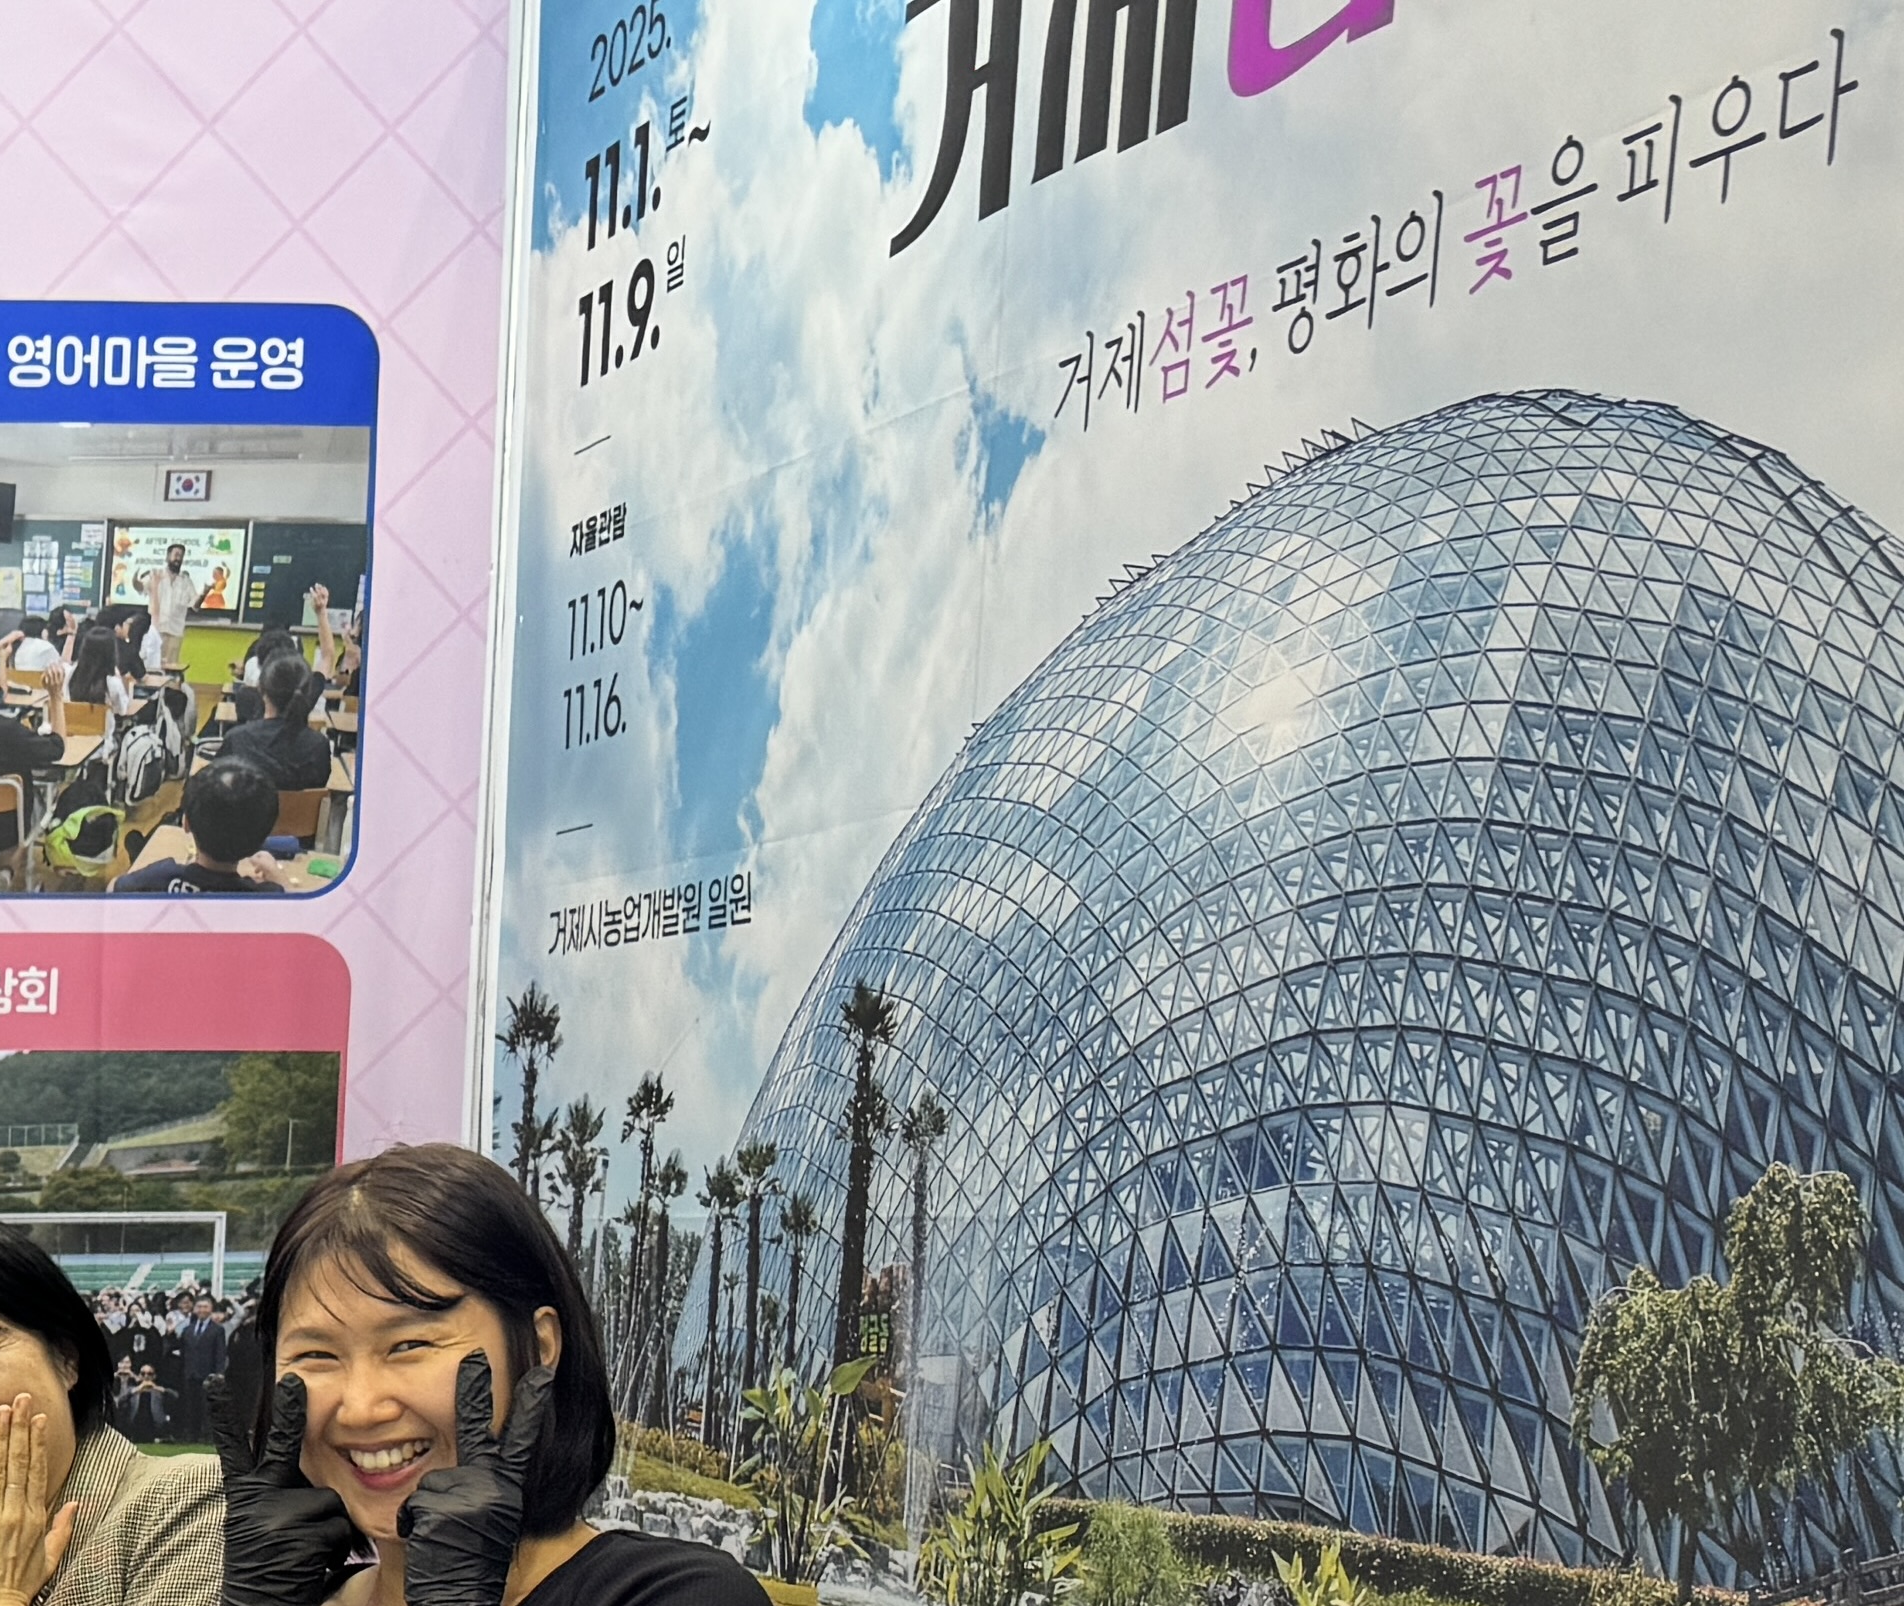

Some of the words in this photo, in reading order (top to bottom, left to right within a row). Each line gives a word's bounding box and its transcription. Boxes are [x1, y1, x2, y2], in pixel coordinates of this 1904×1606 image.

[1272, 189, 1444, 355] 평화의
[1464, 135, 1599, 296] 꽃을
[1617, 28, 1860, 225] 피우다
[7, 335, 197, 390] 영어마을
[210, 336, 305, 392] 운영
[549, 880, 703, 956] 거제시농업개발원
[708, 871, 753, 931] 일원
